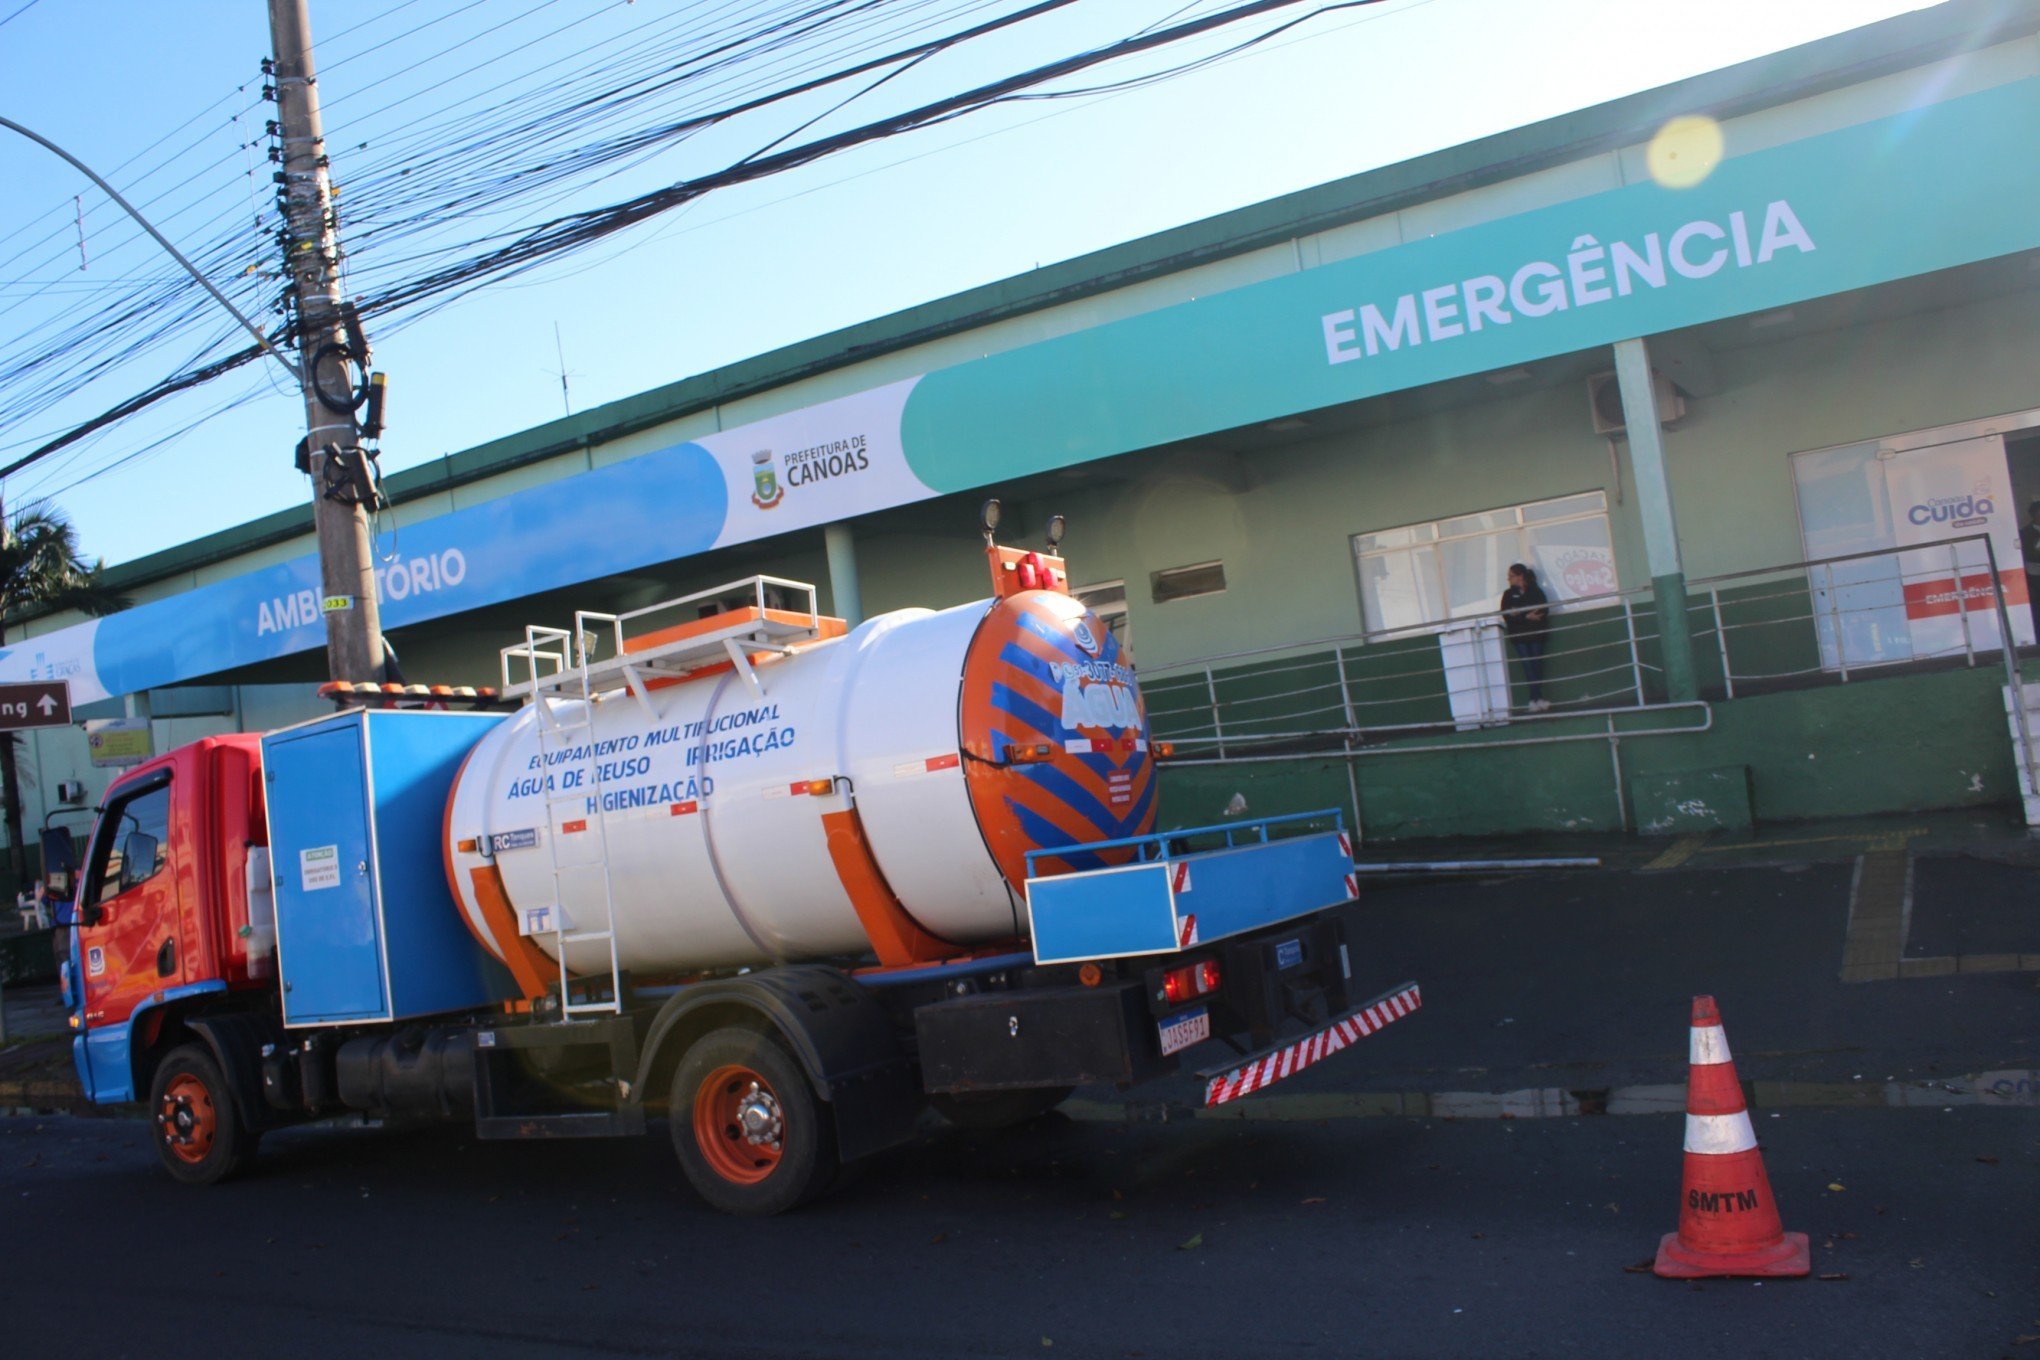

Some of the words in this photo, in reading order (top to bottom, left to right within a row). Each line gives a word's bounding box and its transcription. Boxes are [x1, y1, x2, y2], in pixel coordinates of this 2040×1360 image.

[1321, 199, 1816, 366] EMERGÊNCIA
[784, 440, 850, 466] PREFEITURA
[851, 434, 867, 450] DE
[787, 448, 869, 487] CANOAS
[1908, 495, 1994, 526] Cuida
[686, 727, 795, 767] IRRIGAÇÃO
[507, 774, 555, 800] ÁGUA
[562, 768, 585, 789] DE
[591, 756, 650, 785] REUSO
[586, 775, 714, 815] HGIENIZAÇÃO
[493, 835, 511, 850] RC
[1688, 1189, 1758, 1213] SMTM
